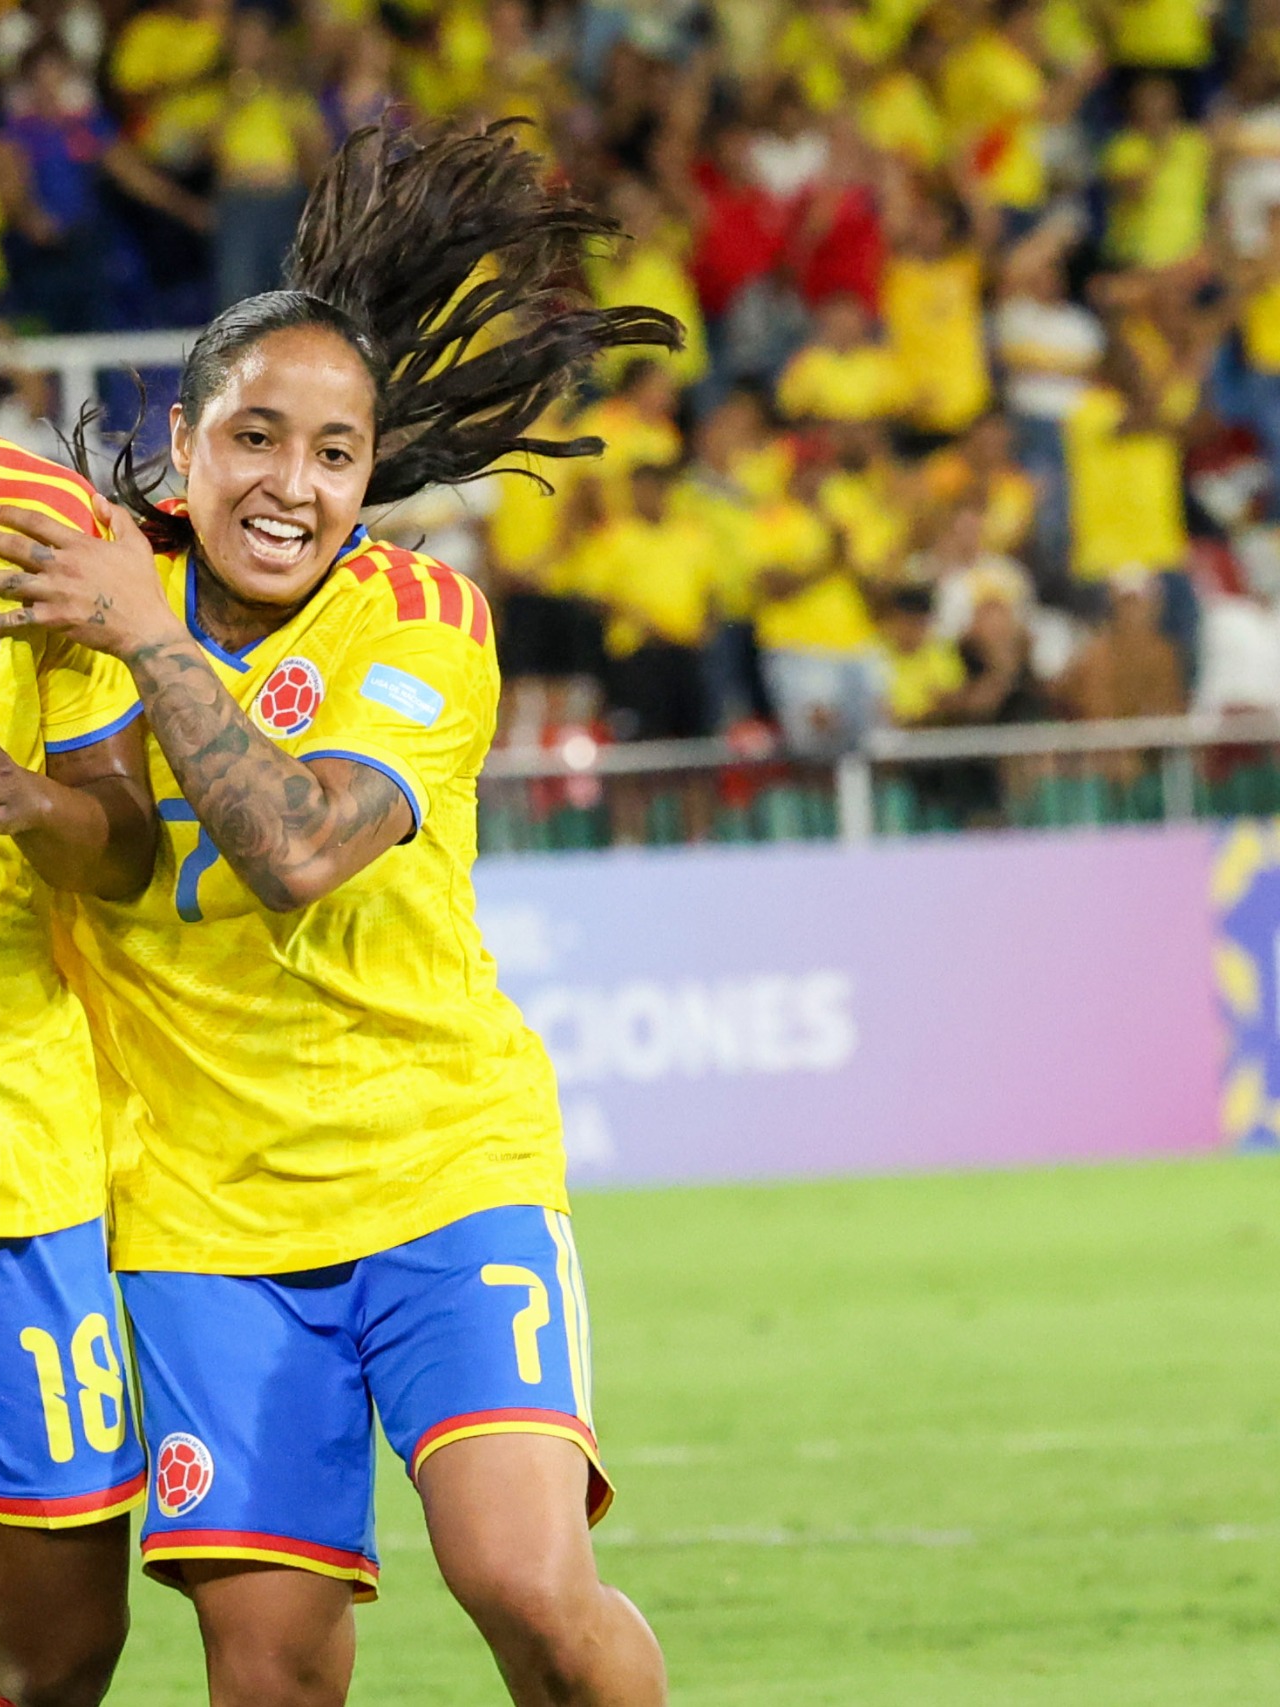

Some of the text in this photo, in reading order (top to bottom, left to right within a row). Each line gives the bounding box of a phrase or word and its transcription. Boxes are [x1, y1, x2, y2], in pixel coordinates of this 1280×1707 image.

[157, 797, 221, 923] 7
[523, 968, 859, 1085] CIONES
[480, 1263, 551, 1385] 7
[19, 1312, 127, 1464] 18
